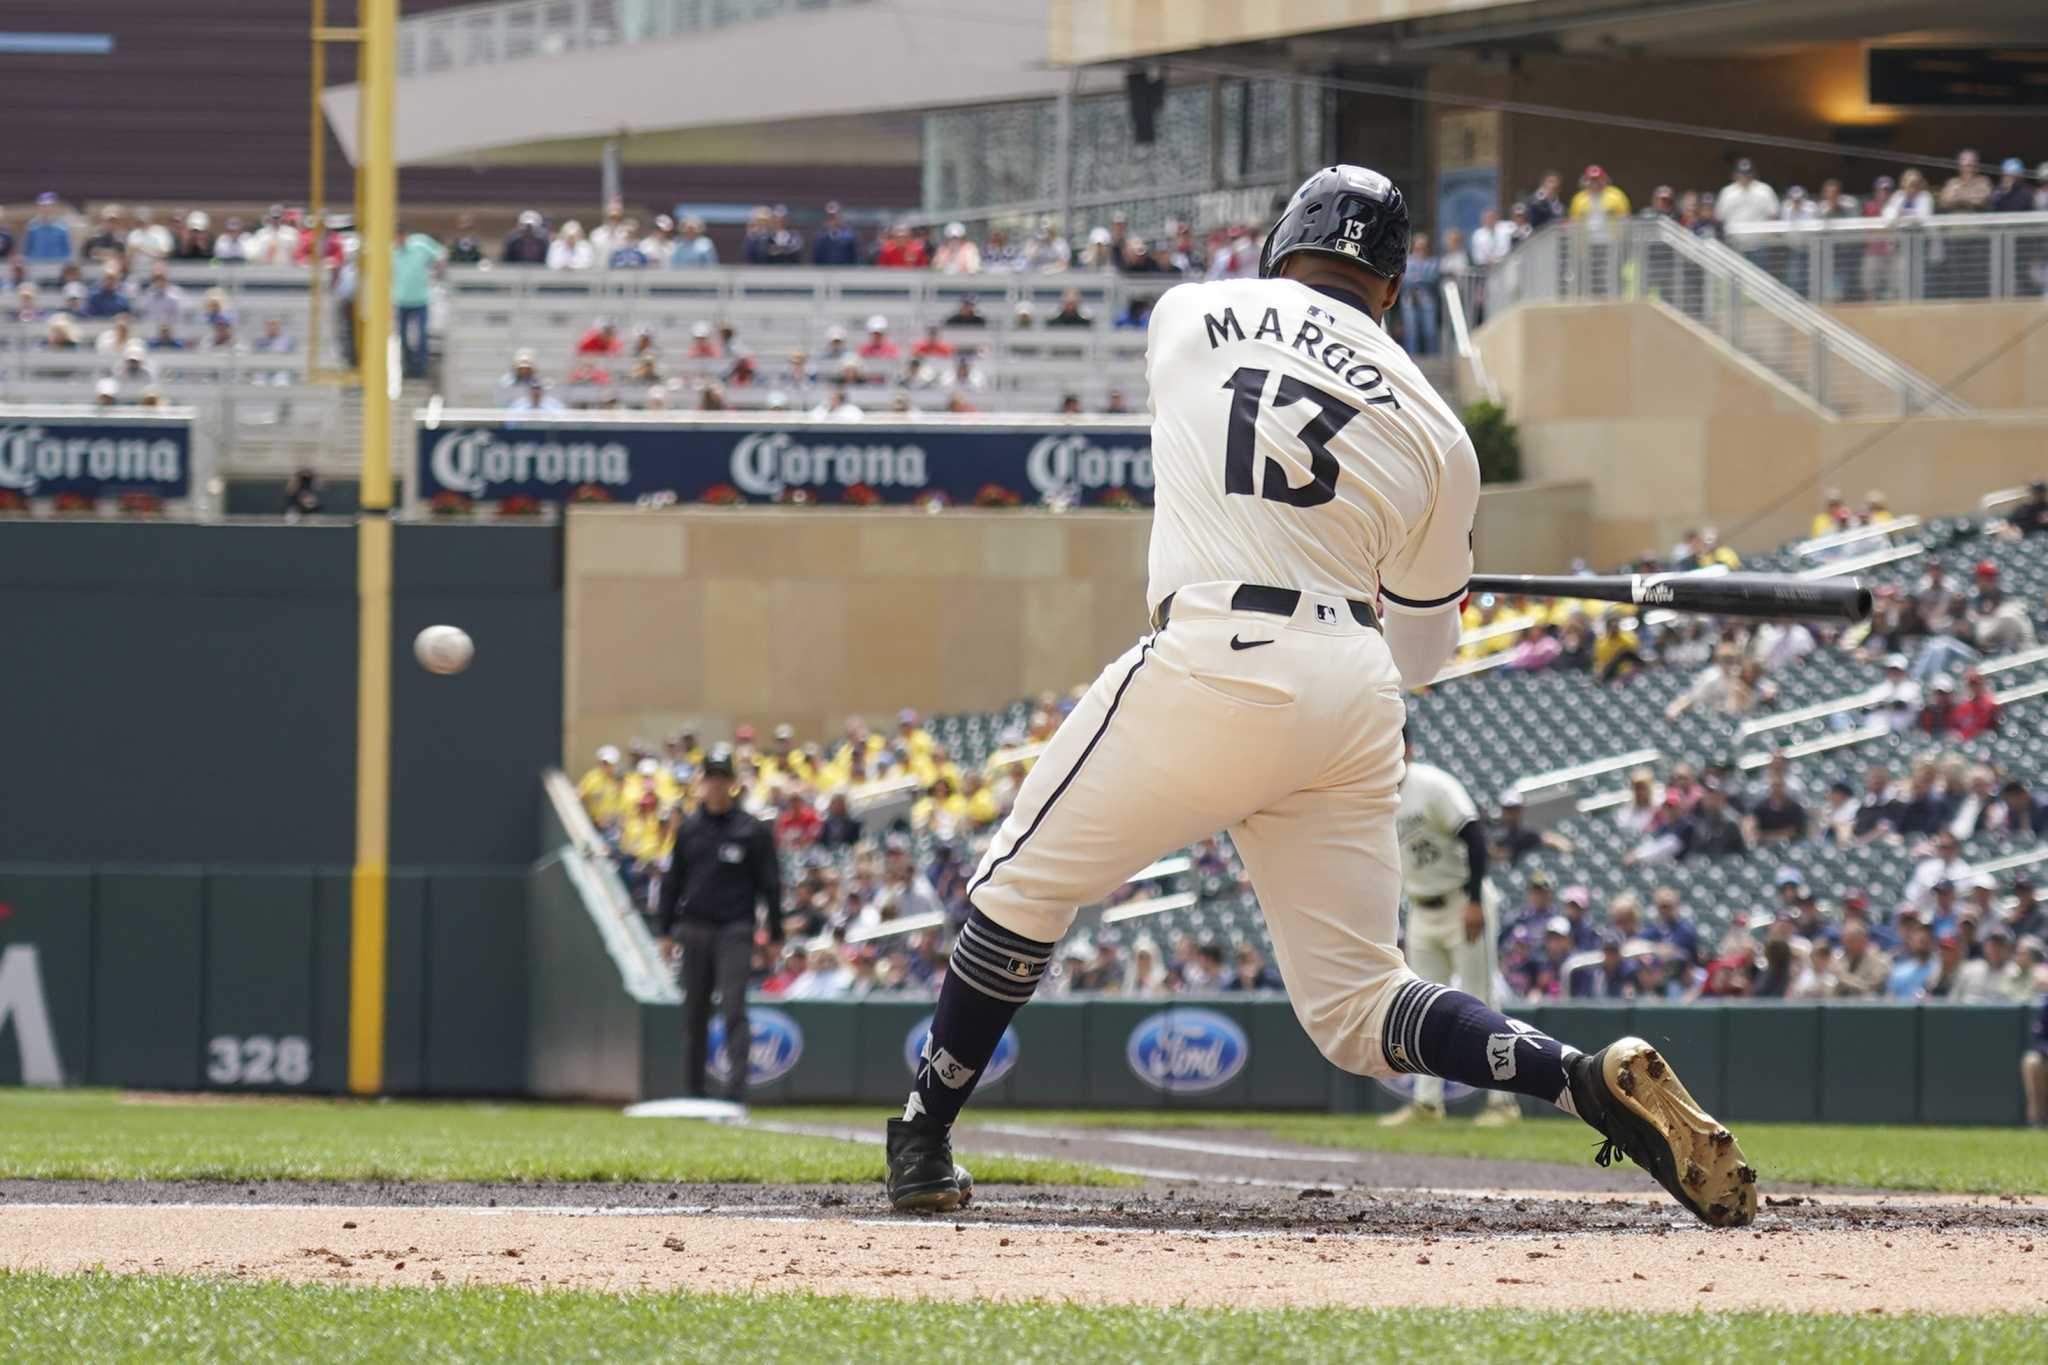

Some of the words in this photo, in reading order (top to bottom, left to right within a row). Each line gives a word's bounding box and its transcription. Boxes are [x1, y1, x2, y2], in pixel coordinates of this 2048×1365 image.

[1343, 218, 1366, 240] 13
[1203, 305, 1401, 411] MARGOT
[0, 427, 180, 496] Corona
[430, 428, 631, 498] Corona
[729, 432, 928, 501] Corona
[1026, 435, 1154, 503] Coro
[1221, 366, 1361, 508] 13
[206, 1034, 311, 1085] 328
[1147, 1026, 1226, 1079] Ford
